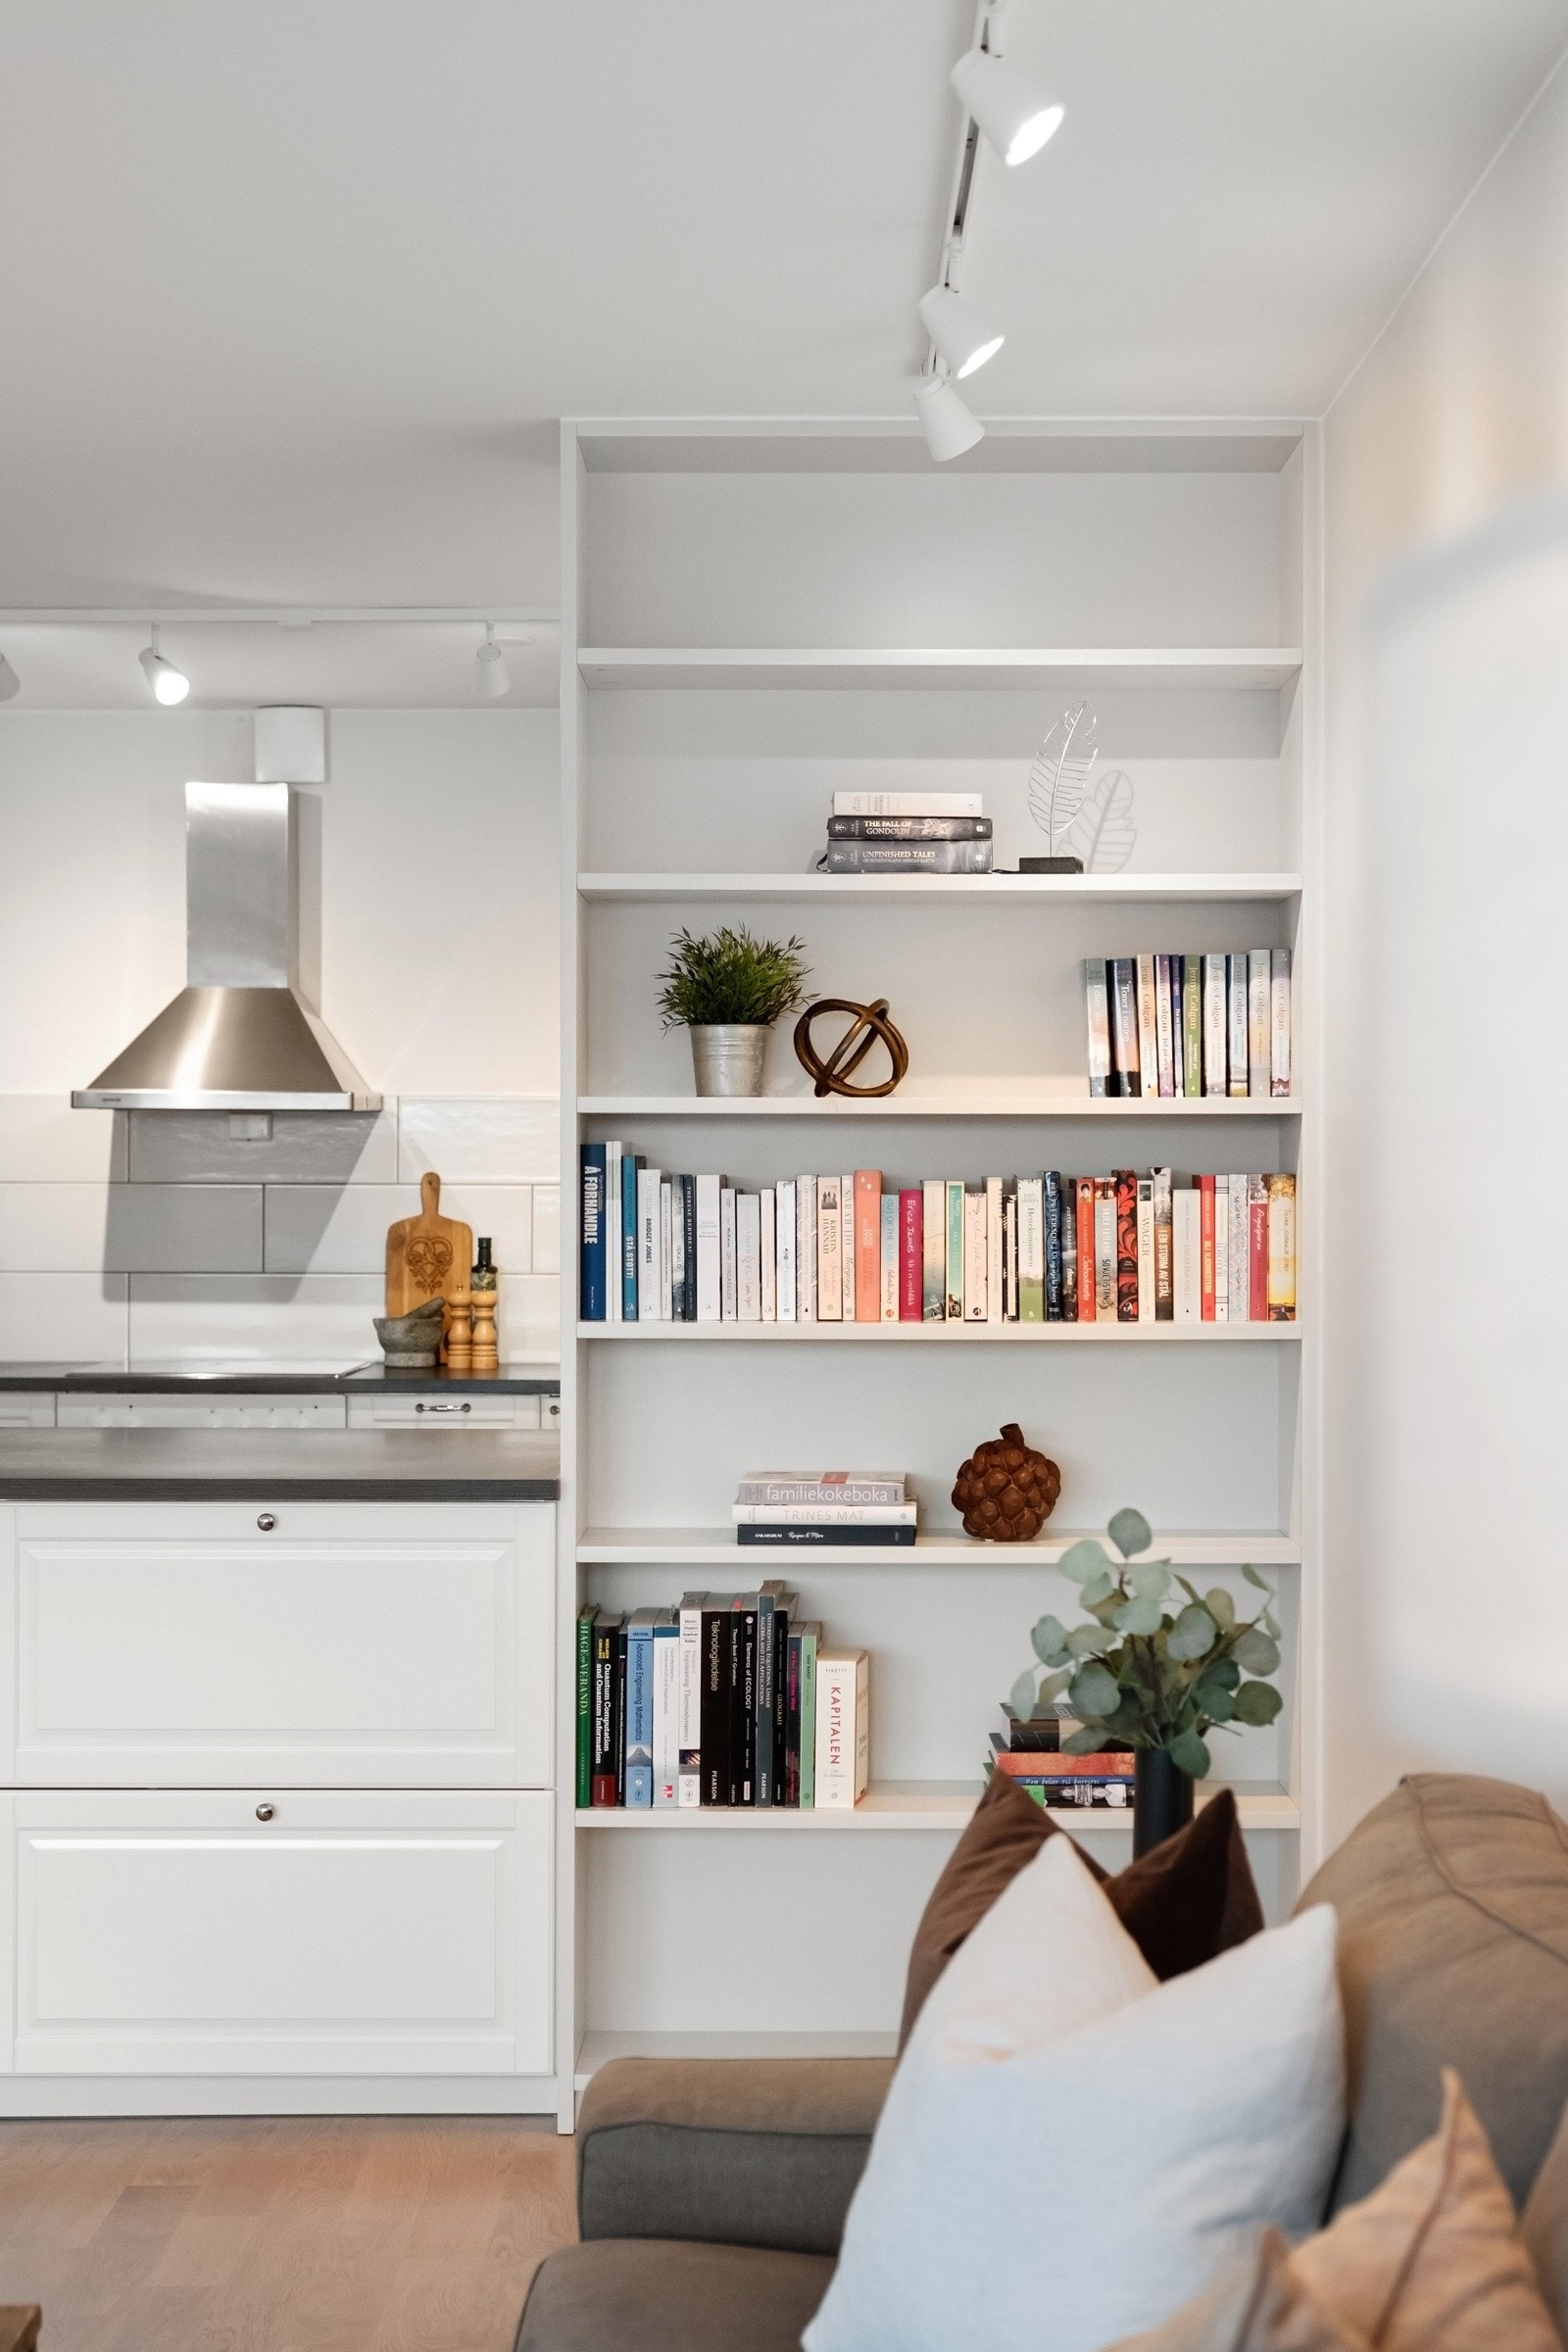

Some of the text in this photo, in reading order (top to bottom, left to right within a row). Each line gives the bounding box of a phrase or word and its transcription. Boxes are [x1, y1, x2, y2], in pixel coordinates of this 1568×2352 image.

[1121, 984, 1130, 1007] Toner
[1188, 967, 1199, 1029] Jenny Colgan
[1212, 995, 1222, 1028] Colgan
[1236, 991, 1245, 1025] Colgan
[1256, 991, 1265, 1025] Colgan
[1160, 998, 1169, 1032] Colgan
[1277, 997, 1286, 1030] Colgan
[584, 1176, 598, 1244] FORHANDLE
[906, 1200, 916, 1224] Erica
[625, 1236, 634, 1251] STÅ
[1141, 1217, 1151, 1256] WAGER
[1158, 1234, 1167, 1244] EN
[1158, 1245, 1167, 1269] STORM
[1159, 1270, 1168, 1281] AV
[1159, 1281, 1169, 1298] STÅL
[766, 1485, 888, 1502] familiekokeboka
[783, 1510, 864, 1521] TRINES MAT
[579, 1624, 589, 1657] HAGE
[709, 1619, 720, 1691] Teknologiledelse
[579, 1663, 588, 1716] VERANDA
[634, 1672, 644, 1705] Engineering
[682, 1650, 691, 1742] Engineering Thermodynamics
[830, 1687, 841, 1765] KAPITALEN
